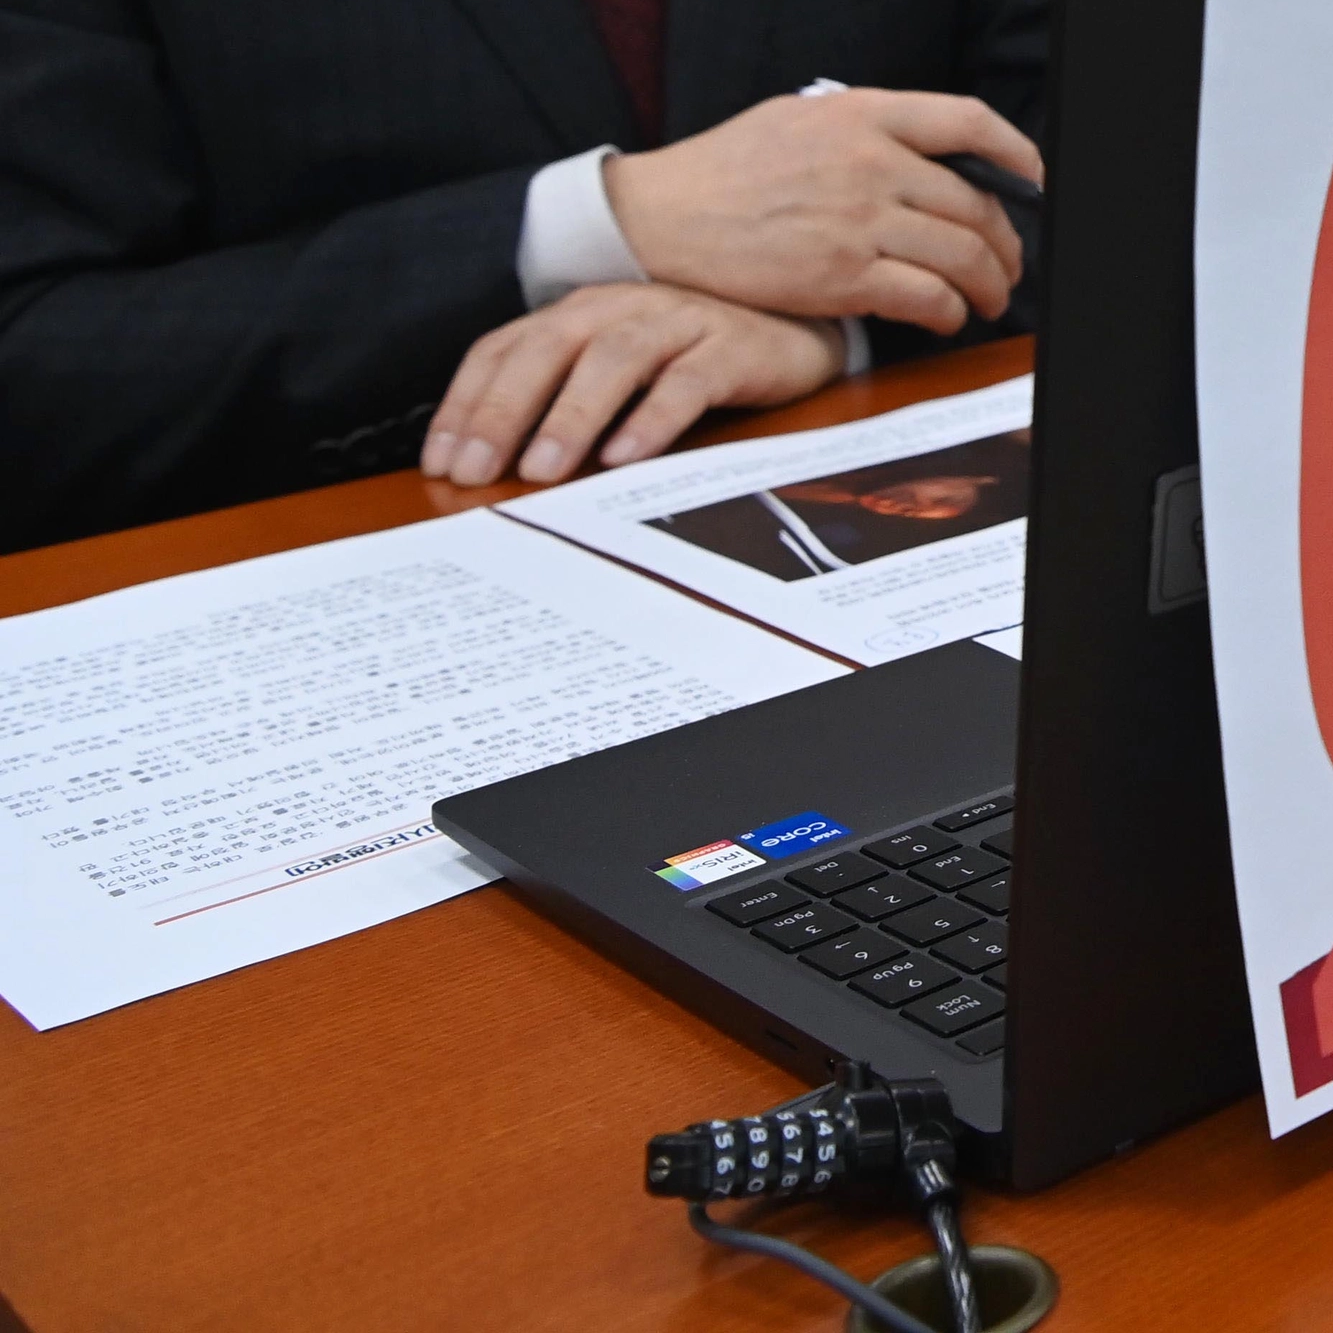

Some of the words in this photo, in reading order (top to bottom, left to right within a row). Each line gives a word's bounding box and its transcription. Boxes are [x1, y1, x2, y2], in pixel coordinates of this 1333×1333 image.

[971, 802, 997, 814] End
[810, 829, 842, 843] intel
[890, 835, 912, 844] Ins
[166, 844, 205, 858] 자료
[673, 842, 726, 864] GRAPHICS
[912, 844, 928, 852] 0
[183, 856, 242, 874] 대하는
[727, 858, 757, 872] intel
[814, 861, 839, 872] Del
[935, 855, 962, 868] End
[89, 859, 151, 881] 91건을
[98, 863, 180, 890] 합의하기
[740, 891, 778, 908] Enter
[884, 895, 902, 904] 2
[805, 925, 822, 934] 3
[934, 919, 950, 928] 5
[854, 951, 869, 960] 6
[985, 945, 1002, 954] 8
[909, 979, 923, 988] 9
[936, 994, 971, 1010] Lock
[944, 999, 981, 1017] Num
[750, 1127, 768, 1143] 8
[783, 1124, 801, 1139] 6
[818, 1121, 834, 1136] 4
[715, 1132, 734, 1149] 5
[752, 1151, 769, 1168] 9
[787, 1147, 803, 1163] 7
[818, 1144, 836, 1161] 5
[717, 1157, 735, 1174] 6
[814, 1170, 832, 1183] 6
